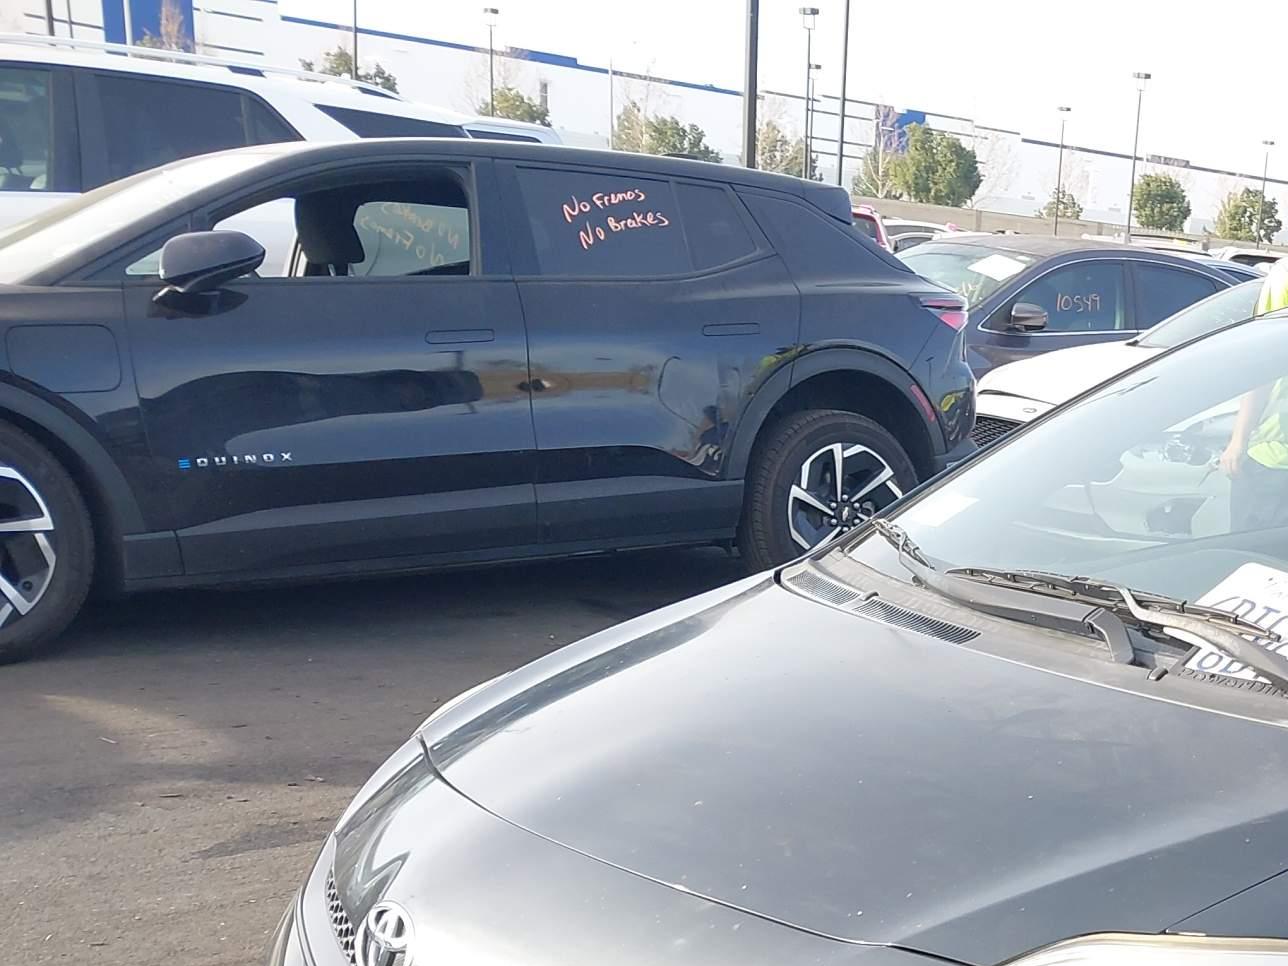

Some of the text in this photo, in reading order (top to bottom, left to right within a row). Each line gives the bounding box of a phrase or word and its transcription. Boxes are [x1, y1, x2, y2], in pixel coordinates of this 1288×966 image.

[562, 195, 591, 223] No
[578, 212, 670, 250] No Brakes
[178, 452, 293, 469] EQUINOX
